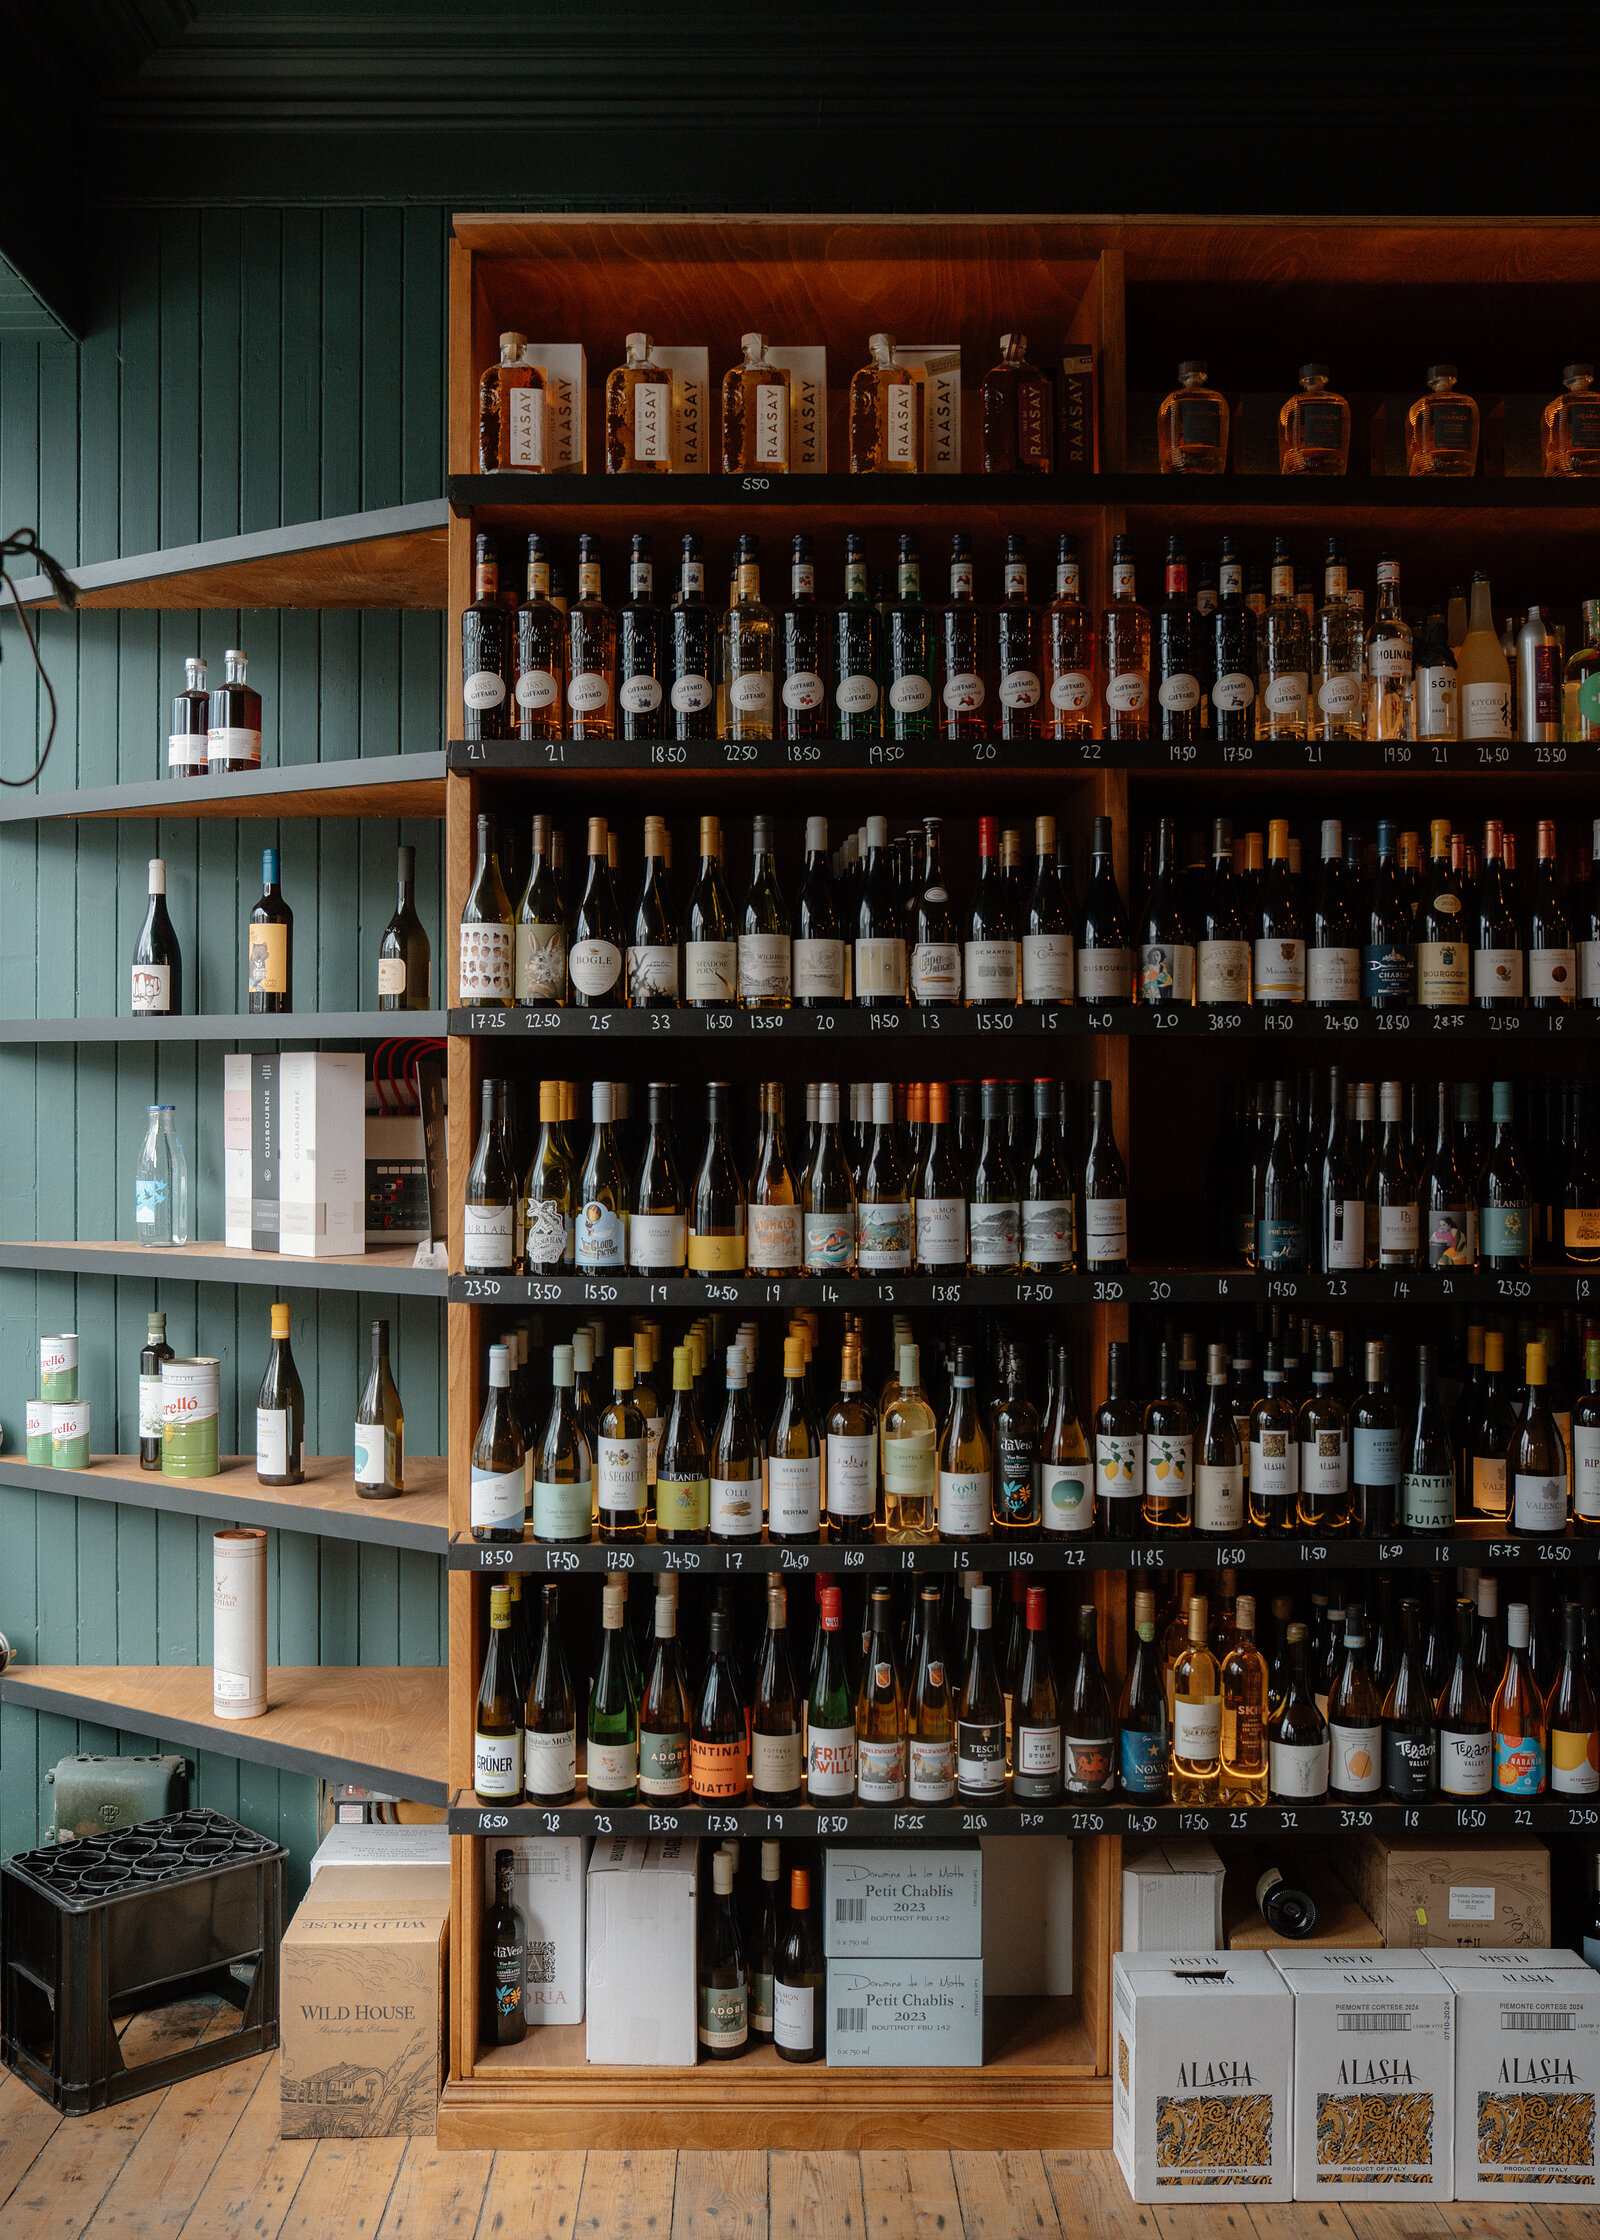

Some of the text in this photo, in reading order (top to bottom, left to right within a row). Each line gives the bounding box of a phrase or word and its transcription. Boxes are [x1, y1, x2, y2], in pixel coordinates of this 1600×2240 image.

[520, 392, 531, 460] RAASAY
[559, 379, 572, 461] RAASAY
[802, 380, 815, 463] RAASAY
[897, 388, 909, 457] RAASAY
[937, 379, 950, 462] RAASAY
[1030, 387, 1041, 455] RAASAY
[742, 478, 770, 490] 550
[627, 684, 654, 694] GIFFARD
[790, 681, 815, 691] GIFFARD
[1008, 680, 1034, 690] GIFFARD
[1115, 682, 1141, 692] GIFFARD
[1220, 682, 1247, 692] GIFFARD
[470, 689, 498, 700] GIFFARD
[1471, 698, 1503, 708] KIYOKO
[467, 744, 486, 760] 21
[546, 745, 564, 762] 21
[972, 744, 996, 760] 20
[1080, 744, 1102, 758] 22
[1304, 746, 1322, 762] 21
[1432, 747, 1448, 762] 21
[576, 956, 612, 966] BOGLE
[696, 960, 728, 968] SHADOW
[920, 950, 942, 974] Cape
[932, 961, 956, 973] HEIGHTS
[696, 967, 719, 975] POINT
[589, 1014, 612, 1030] 25
[651, 1014, 670, 1030] 33
[816, 1016, 834, 1030] 20
[922, 1014, 940, 1029] 13
[1041, 1012, 1058, 1028] 15
[1088, 1014, 1112, 1028] 40
[1153, 1013, 1178, 1028] 20
[1549, 1016, 1564, 1030] 18
[926, 1206, 958, 1214] SALMON
[1493, 1200, 1529, 1208] PLANETA
[468, 1225, 507, 1234] URLAR
[755, 1219, 796, 1231] ANIMALIA
[590, 1239, 614, 1252] CLOUD
[596, 1246, 618, 1260] FACTORY
[650, 1284, 668, 1302] 19
[766, 1284, 780, 1302] 19
[822, 1285, 838, 1302] 14
[878, 1285, 894, 1300] 13
[1149, 1280, 1171, 1300] 30
[1218, 1279, 1228, 1294] 16
[1327, 1280, 1347, 1296] 23
[1394, 1281, 1410, 1298] 14
[1442, 1279, 1454, 1294] 21
[1576, 1279, 1590, 1300] 18
[608, 1470, 644, 1482] SEGRETA
[669, 1472, 704, 1482] PLANETA
[1404, 1476, 1454, 1488] CANTIN
[725, 1488, 748, 1497] OLLI
[1406, 1513, 1454, 1525] PUIATT
[726, 1552, 743, 1569] 17
[902, 1551, 915, 1568] 18
[953, 1551, 970, 1568] 15
[1064, 1550, 1086, 1565] 27
[1436, 1546, 1449, 1562] 18
[650, 1751, 687, 1761] ADOBE
[816, 1745, 853, 1760] FRITZ
[970, 1744, 1000, 1753] TESCH
[1396, 1740, 1436, 1760] Teliani
[1451, 1740, 1490, 1759] Teliani
[477, 1750, 512, 1772] GRÜNER
[1511, 1757, 1542, 1766] NARANJO
[1135, 1764, 1168, 1774] NOVAS
[542, 1812, 560, 1832] 28
[594, 1814, 612, 1832] 23
[766, 1814, 784, 1830] 19
[1229, 1812, 1248, 1828] 25
[1280, 1812, 1299, 1828] 32
[1405, 1810, 1420, 1827] 18
[1514, 1810, 1534, 1825] 22
[832, 1864, 901, 1882] Domaine
[907, 1866, 918, 1878] de
[938, 1865, 964, 1878] Motte
[865, 1884, 954, 1898] Petit Chablis
[893, 1902, 926, 1912] 2023
[302, 1921, 426, 1930] WILD HOUSE
[1478, 1954, 1530, 1963] ALASIA
[1502, 1974, 1555, 1984] ALASIA
[866, 1993, 954, 2007] Petit Chablis
[300, 2004, 416, 2020] WILD HOUSE
[710, 2004, 745, 2015] ADOBE
[894, 2011, 926, 2022] 2023
[316, 2024, 343, 2034] Shaped
[344, 2025, 352, 2036] by
[366, 2023, 401, 2034] Elements
[1176, 2060, 1256, 2088] ALASIA
[1337, 2058, 1416, 2084] ALASIA
[1498, 2057, 1578, 2085] ALASIA
